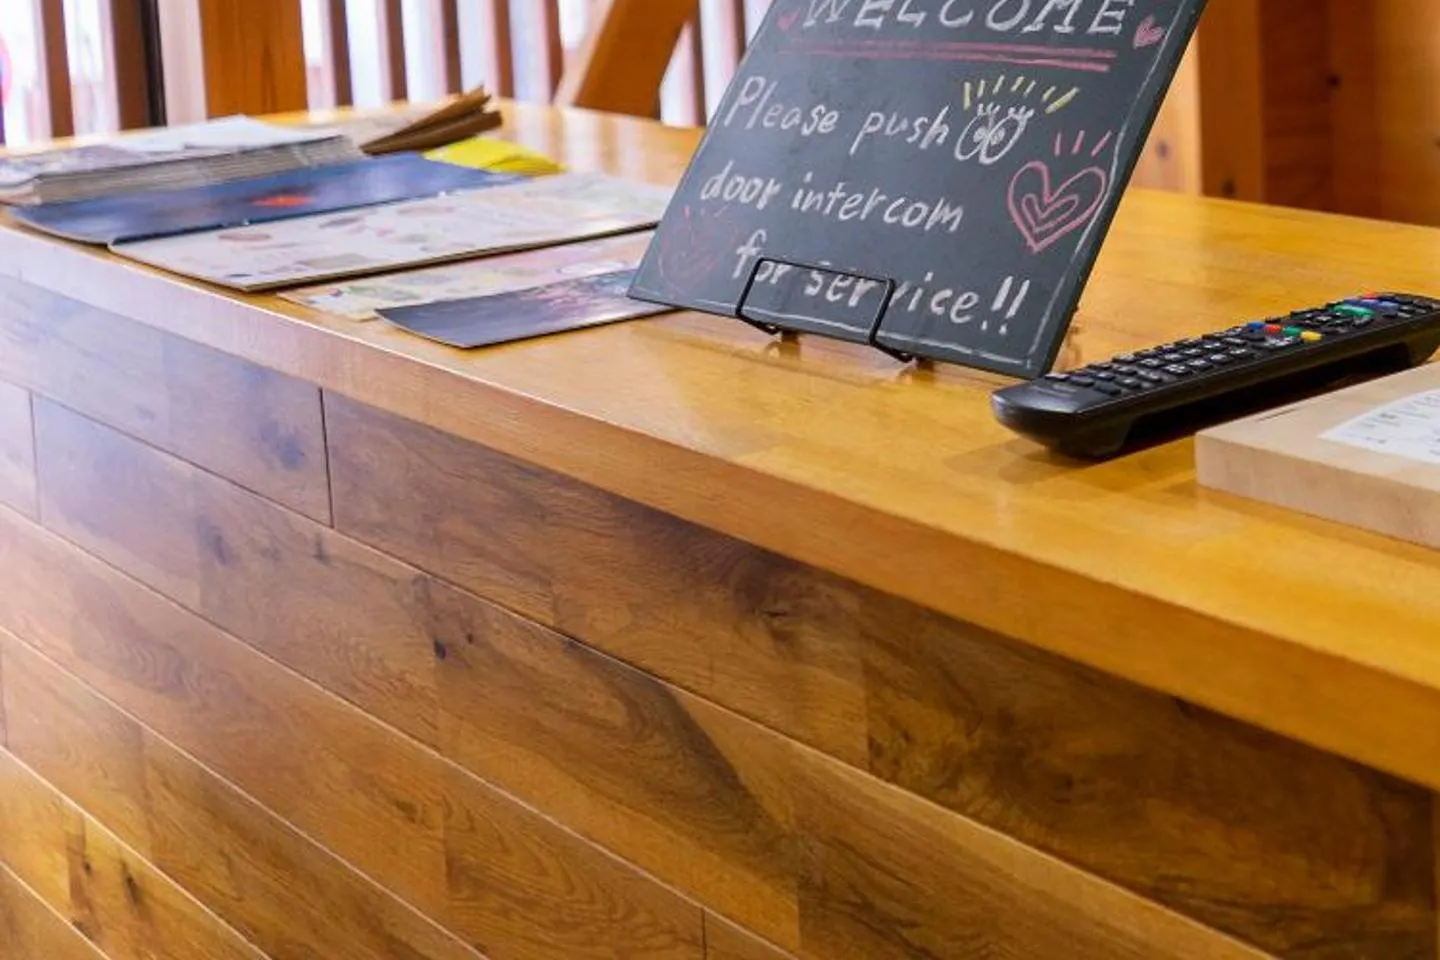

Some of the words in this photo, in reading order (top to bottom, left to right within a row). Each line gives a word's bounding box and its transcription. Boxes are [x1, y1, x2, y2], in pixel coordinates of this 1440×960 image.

[723, 74, 838, 136] Please
[850, 105, 951, 155] push
[700, 161, 781, 205] door
[792, 171, 965, 234] intercom
[732, 228, 791, 284] for
